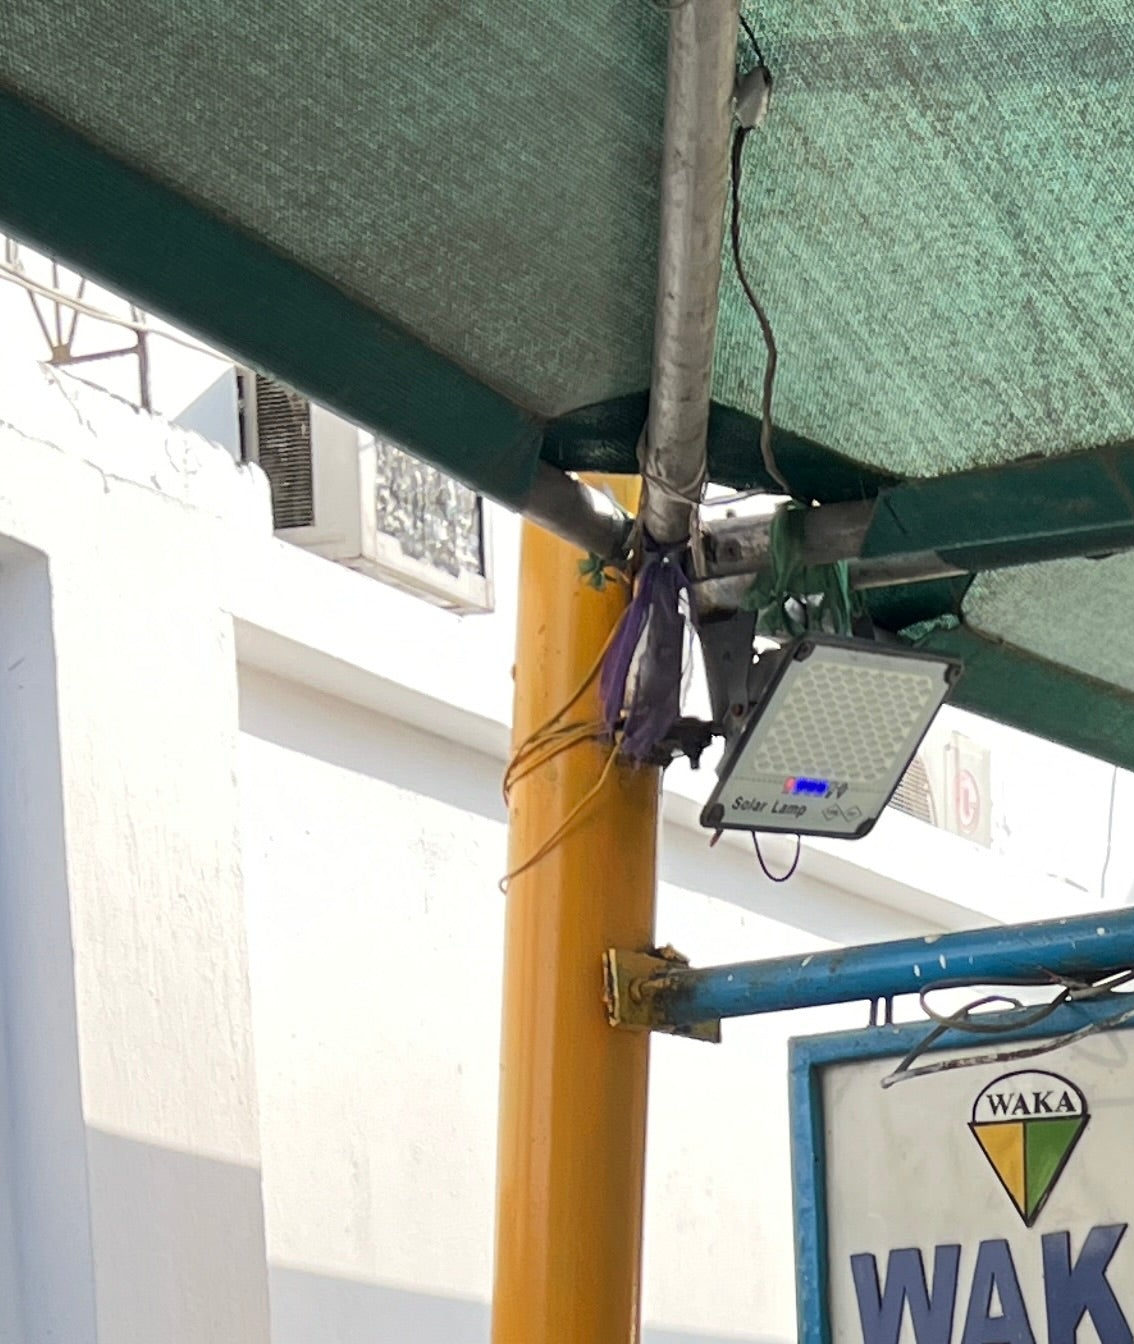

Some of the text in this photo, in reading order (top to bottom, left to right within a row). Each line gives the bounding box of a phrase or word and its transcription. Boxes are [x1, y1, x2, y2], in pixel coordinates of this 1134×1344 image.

[732, 796, 768, 813] Solar
[771, 801, 807, 819] Lamp
[986, 1090, 1077, 1116] WAKA
